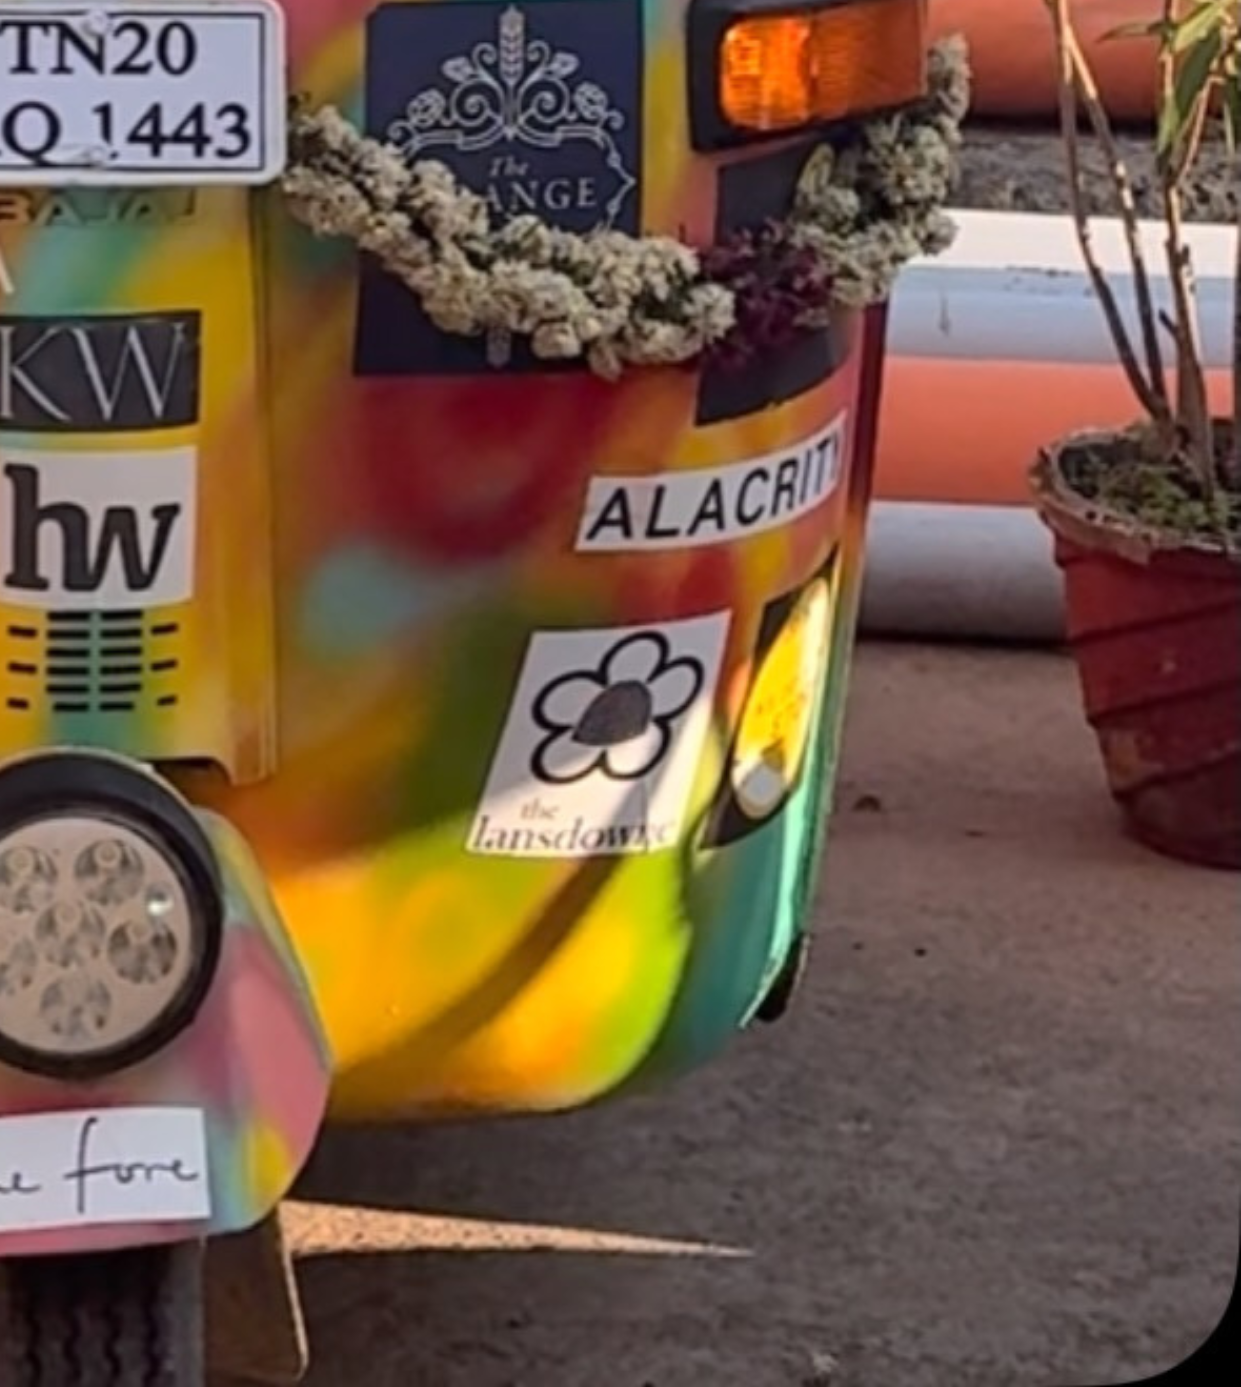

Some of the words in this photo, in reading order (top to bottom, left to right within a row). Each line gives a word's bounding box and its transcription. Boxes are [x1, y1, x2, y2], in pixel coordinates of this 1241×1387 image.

[90, 102, 252, 161] 1443
[487, 178, 598, 212] ANGE
[4, 463, 182, 593] hw
